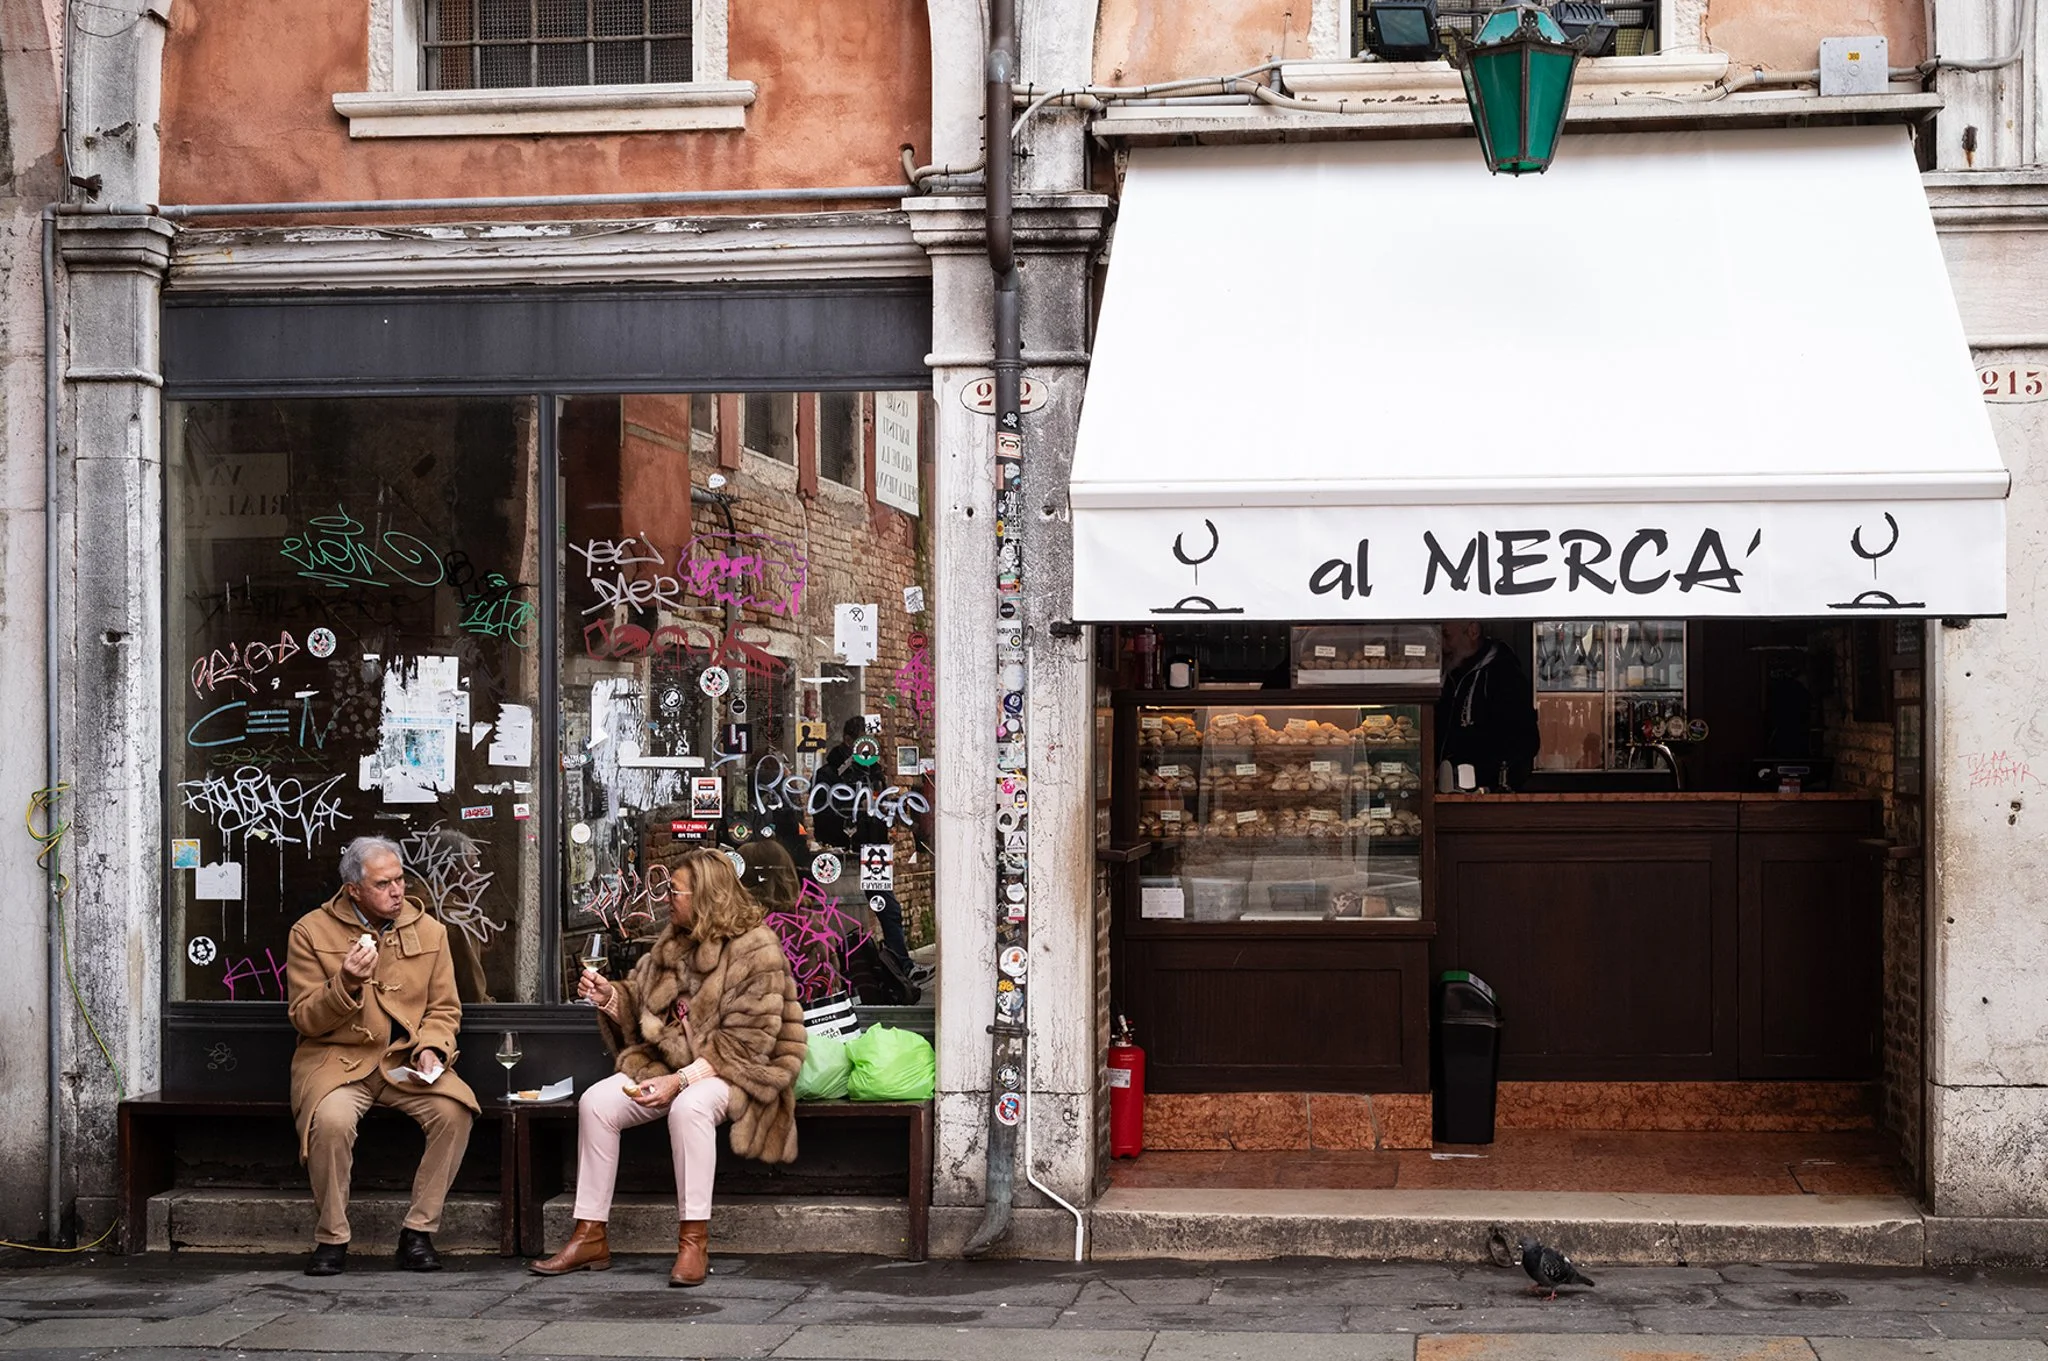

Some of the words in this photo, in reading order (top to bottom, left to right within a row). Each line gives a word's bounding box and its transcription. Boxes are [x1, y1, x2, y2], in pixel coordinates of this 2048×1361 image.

[976, 382, 1031, 406] 22
[1981, 370, 2043, 395] 215
[1309, 538, 1373, 600] al
[1423, 527, 1762, 596] MERCA'
[811, 1014, 837, 1024] SEPHORA
